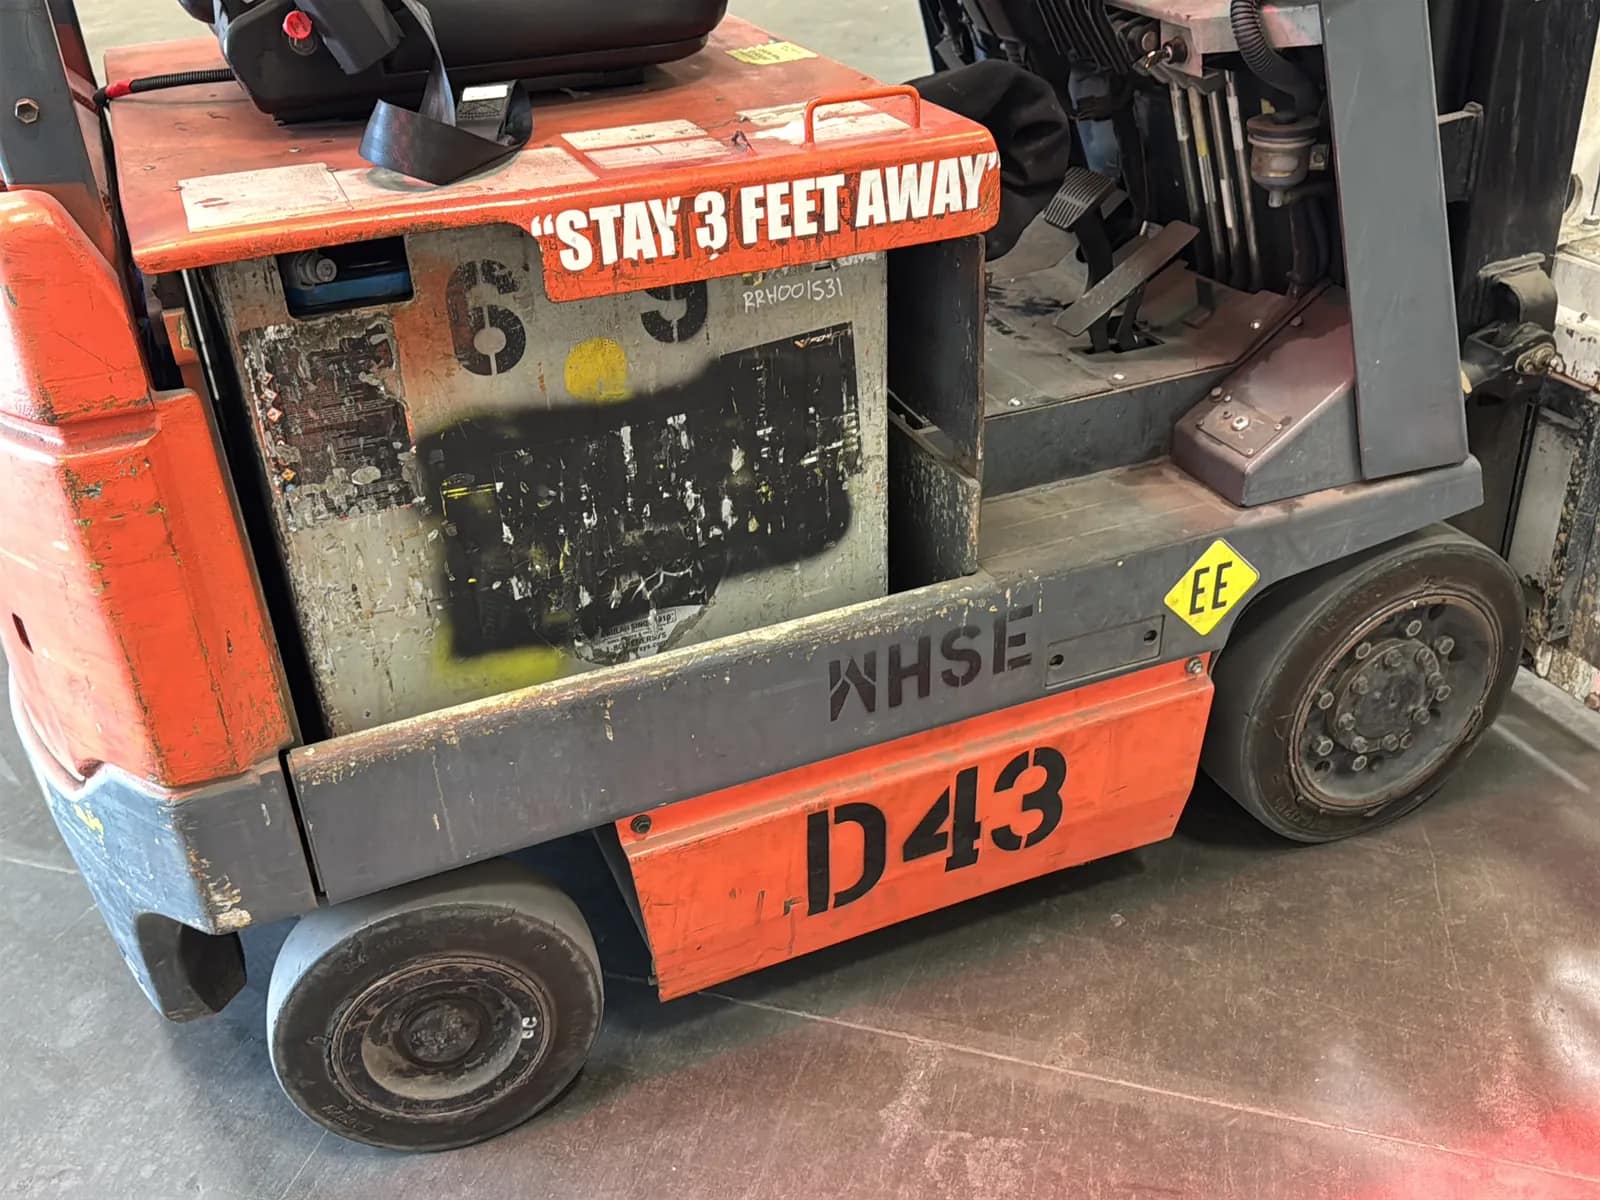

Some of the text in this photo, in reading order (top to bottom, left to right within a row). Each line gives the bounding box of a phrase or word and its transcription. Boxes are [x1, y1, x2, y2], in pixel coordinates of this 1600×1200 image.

[694, 191, 728, 260] 3
[741, 174, 845, 245] FEET
[446, 259, 526, 376] 6
[1189, 561, 1233, 616] EE
[828, 604, 1034, 722] WHSE
[807, 746, 1067, 917] D43
